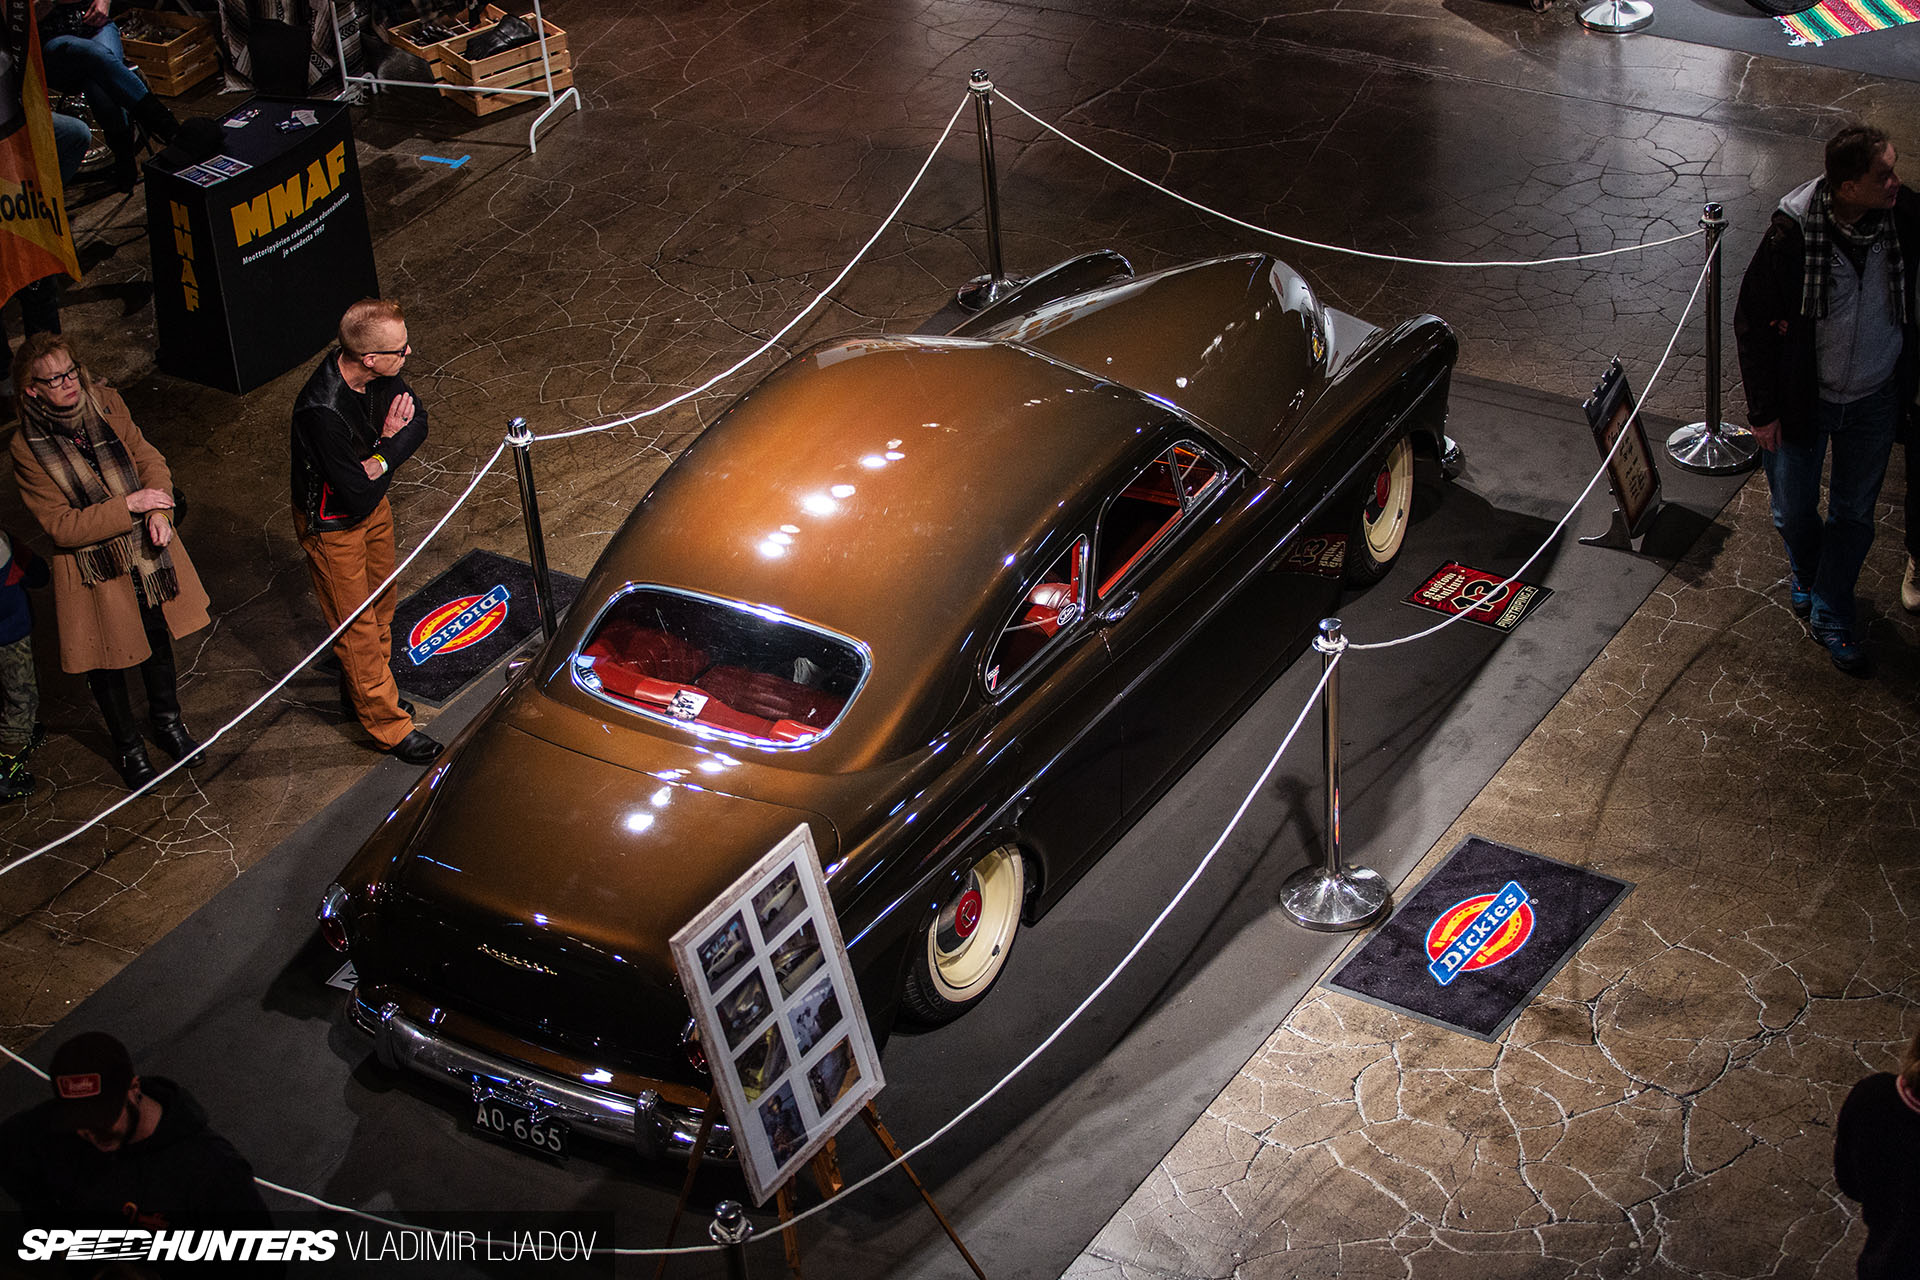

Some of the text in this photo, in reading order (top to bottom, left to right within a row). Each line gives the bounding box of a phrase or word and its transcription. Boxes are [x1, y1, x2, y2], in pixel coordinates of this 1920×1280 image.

[0, 180, 64, 237] odial
[231, 140, 346, 248] MMAF
[169, 199, 199, 312] MMAF
[242, 236, 290, 265] Moottoripyörien
[290, 233, 315, 253] vuodesta
[418, 593, 499, 655] Dickies
[1450, 579, 1510, 613] 13
[1440, 893, 1518, 972] Dickies
